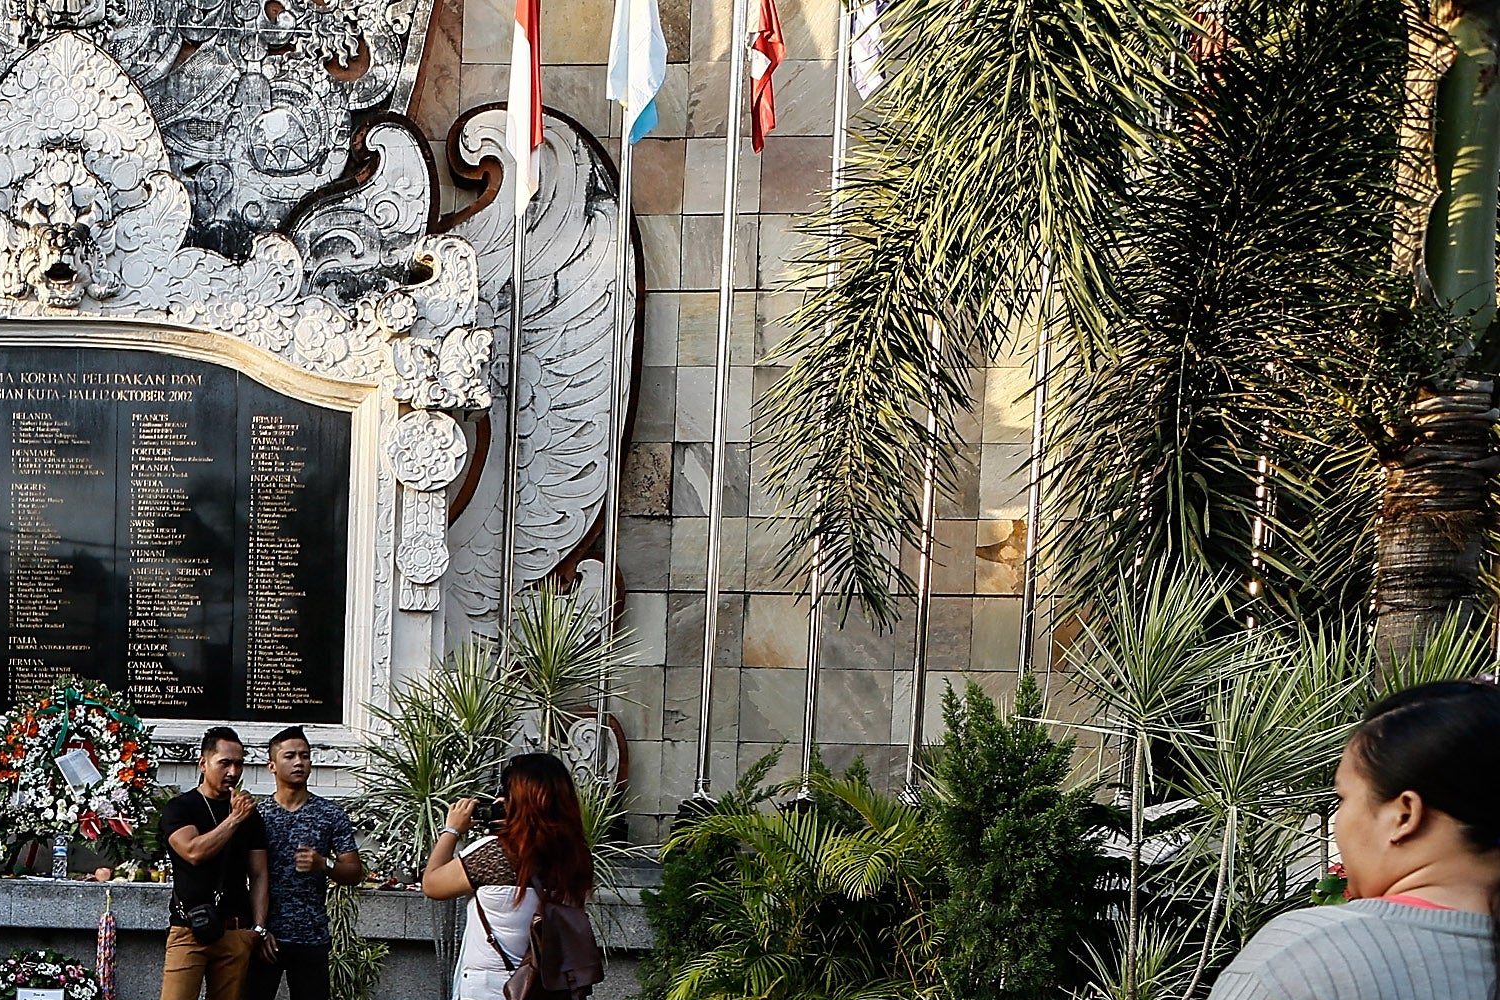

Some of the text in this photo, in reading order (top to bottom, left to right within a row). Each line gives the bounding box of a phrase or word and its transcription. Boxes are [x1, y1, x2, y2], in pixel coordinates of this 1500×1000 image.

[20, 373, 76, 384] KORBAN
[172, 375, 202, 386] BOM
[28, 390, 60, 400] KUTA
[111, 390, 166, 402] OKTOBER
[169, 390, 193, 402] 2002
[12, 412, 52, 420] BELANDA
[251, 437, 285, 445] TAIWAN
[12, 449, 56, 457] DENMARK
[132, 448, 172, 456] PORTUGIS
[250, 475, 297, 483] INDONESIA
[11, 483, 46, 491] INGGRIS
[130, 519, 155, 527] SWISS
[130, 549, 166, 557] YUNANI
[176, 568, 213, 576] SERIKAT
[129, 619, 159, 627] BRASIL
[9, 636, 37, 644] ITALIA
[128, 644, 168, 652] EQUADOR
[8, 658, 45, 666] JERMAN
[128, 661, 163, 669] CANADA
[166, 686, 204, 694] SELATAN
